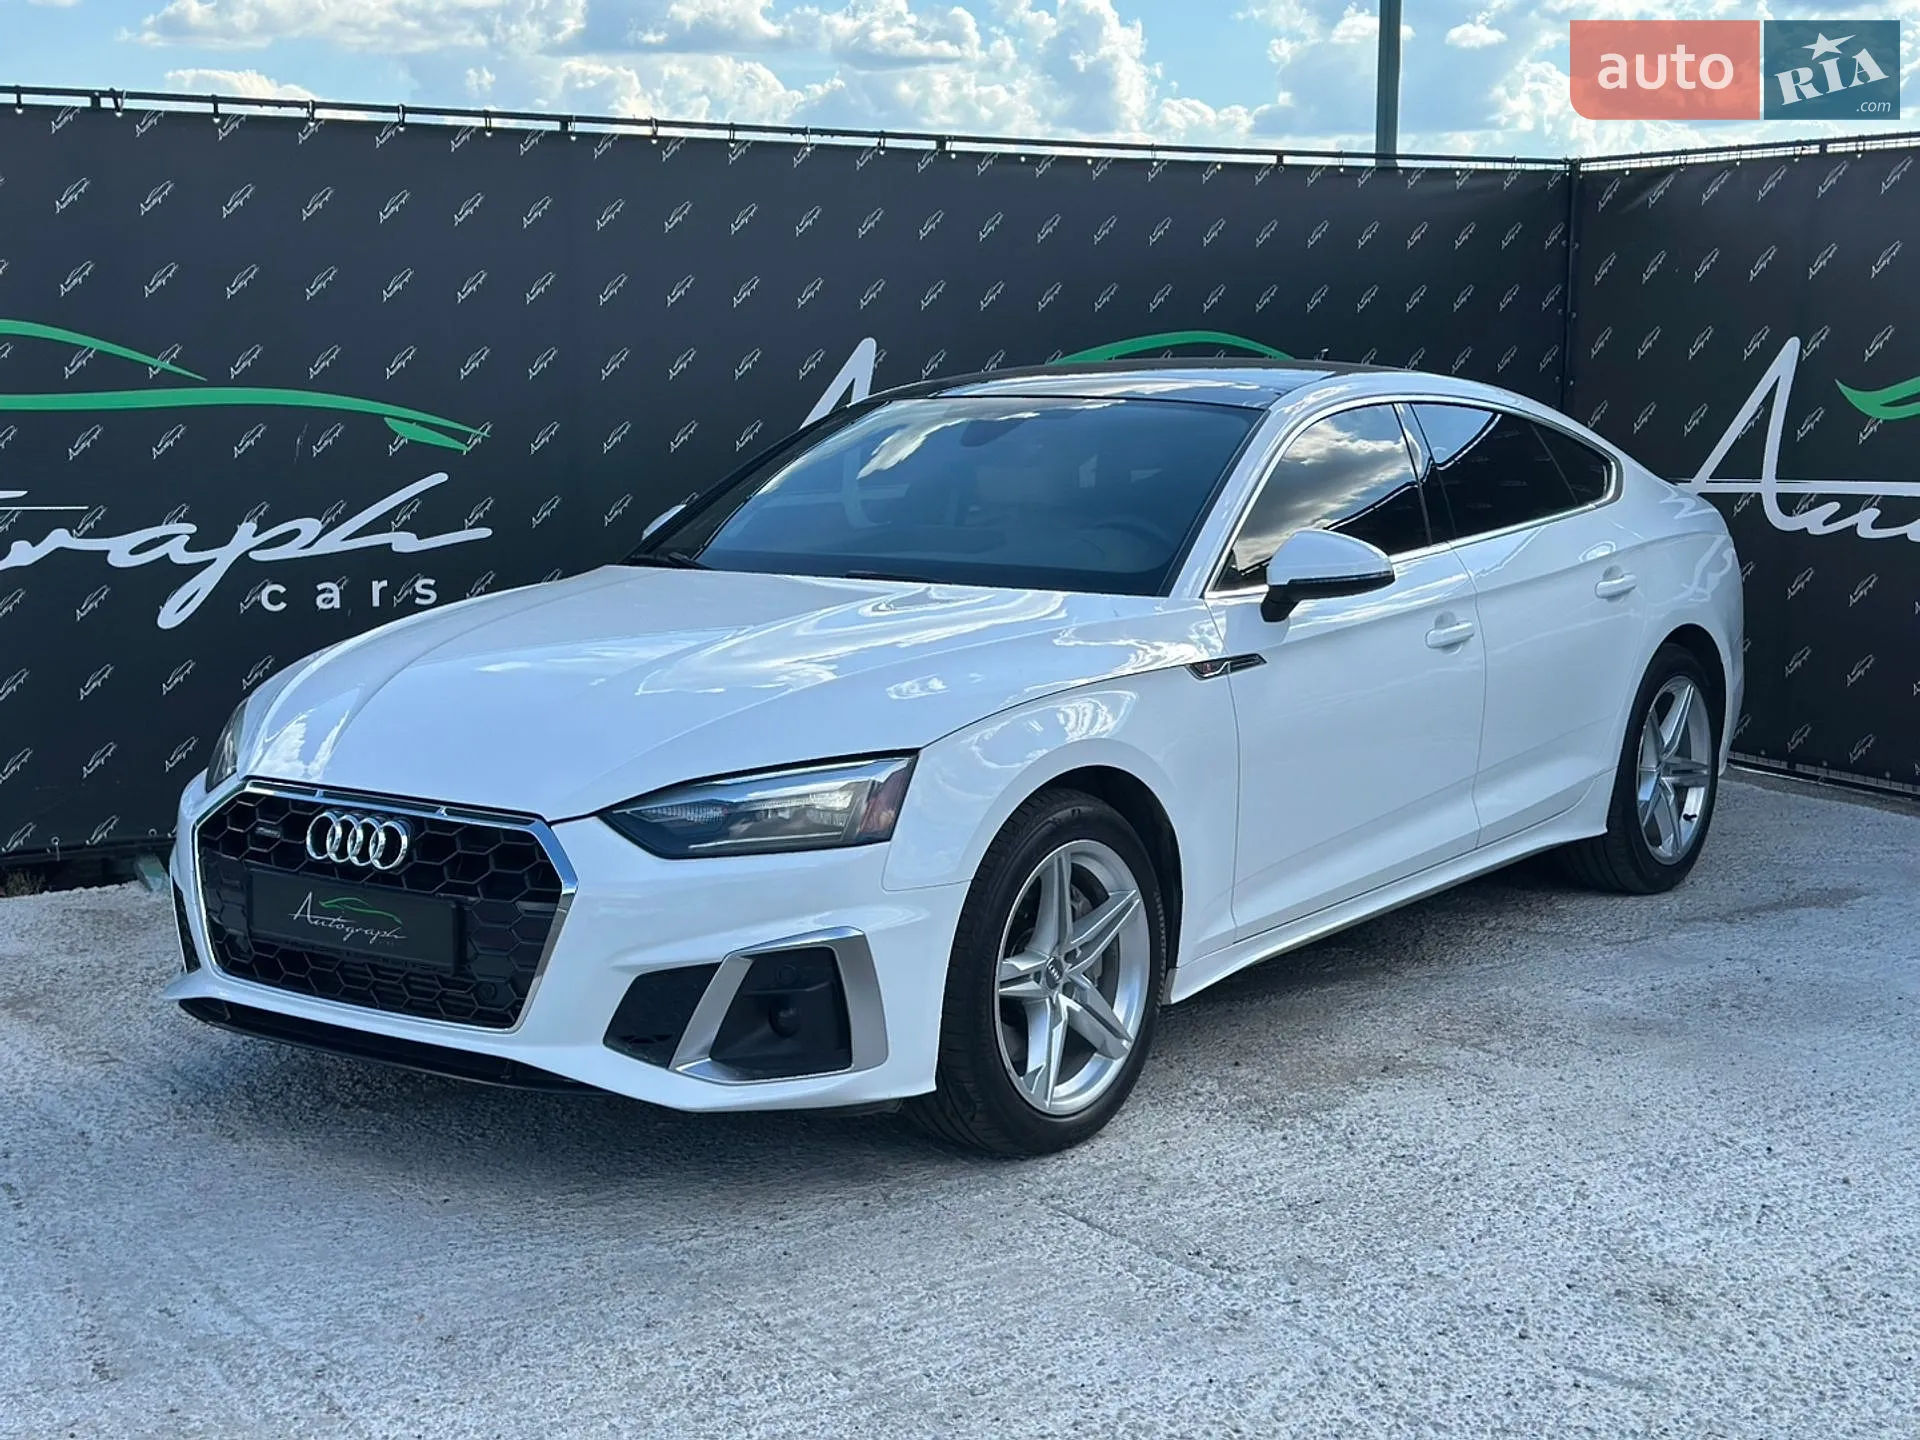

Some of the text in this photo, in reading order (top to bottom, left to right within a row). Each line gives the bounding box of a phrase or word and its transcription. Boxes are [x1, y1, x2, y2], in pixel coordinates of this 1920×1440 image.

[1676, 336, 1920, 543] Au
[0, 472, 493, 630] raph
[260, 576, 438, 612] cars
[288, 891, 408, 945] Autograph
